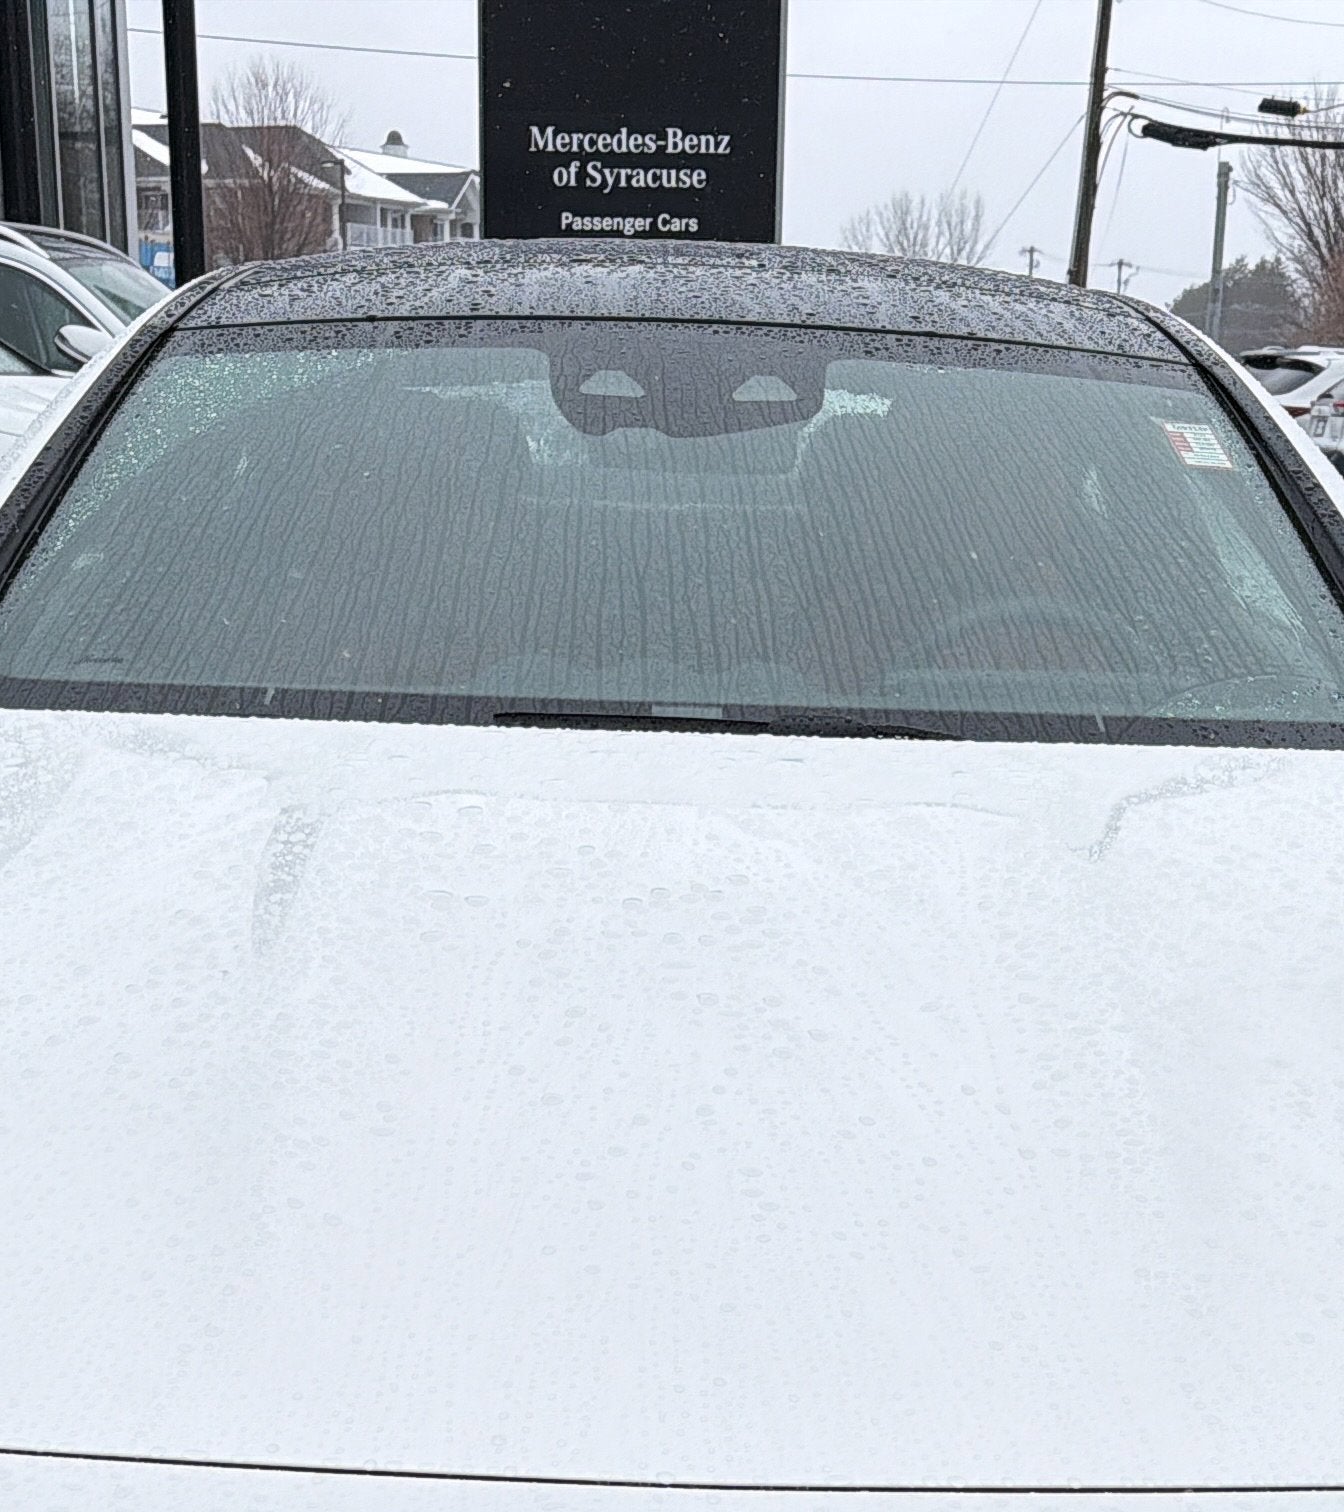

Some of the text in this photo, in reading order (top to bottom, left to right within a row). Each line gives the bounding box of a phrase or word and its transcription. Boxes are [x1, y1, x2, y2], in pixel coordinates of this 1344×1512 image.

[528, 125, 732, 155] Mercedes-Benz
[552, 160, 707, 193] of Syracuse
[560, 211, 699, 236] Passenger Cars
